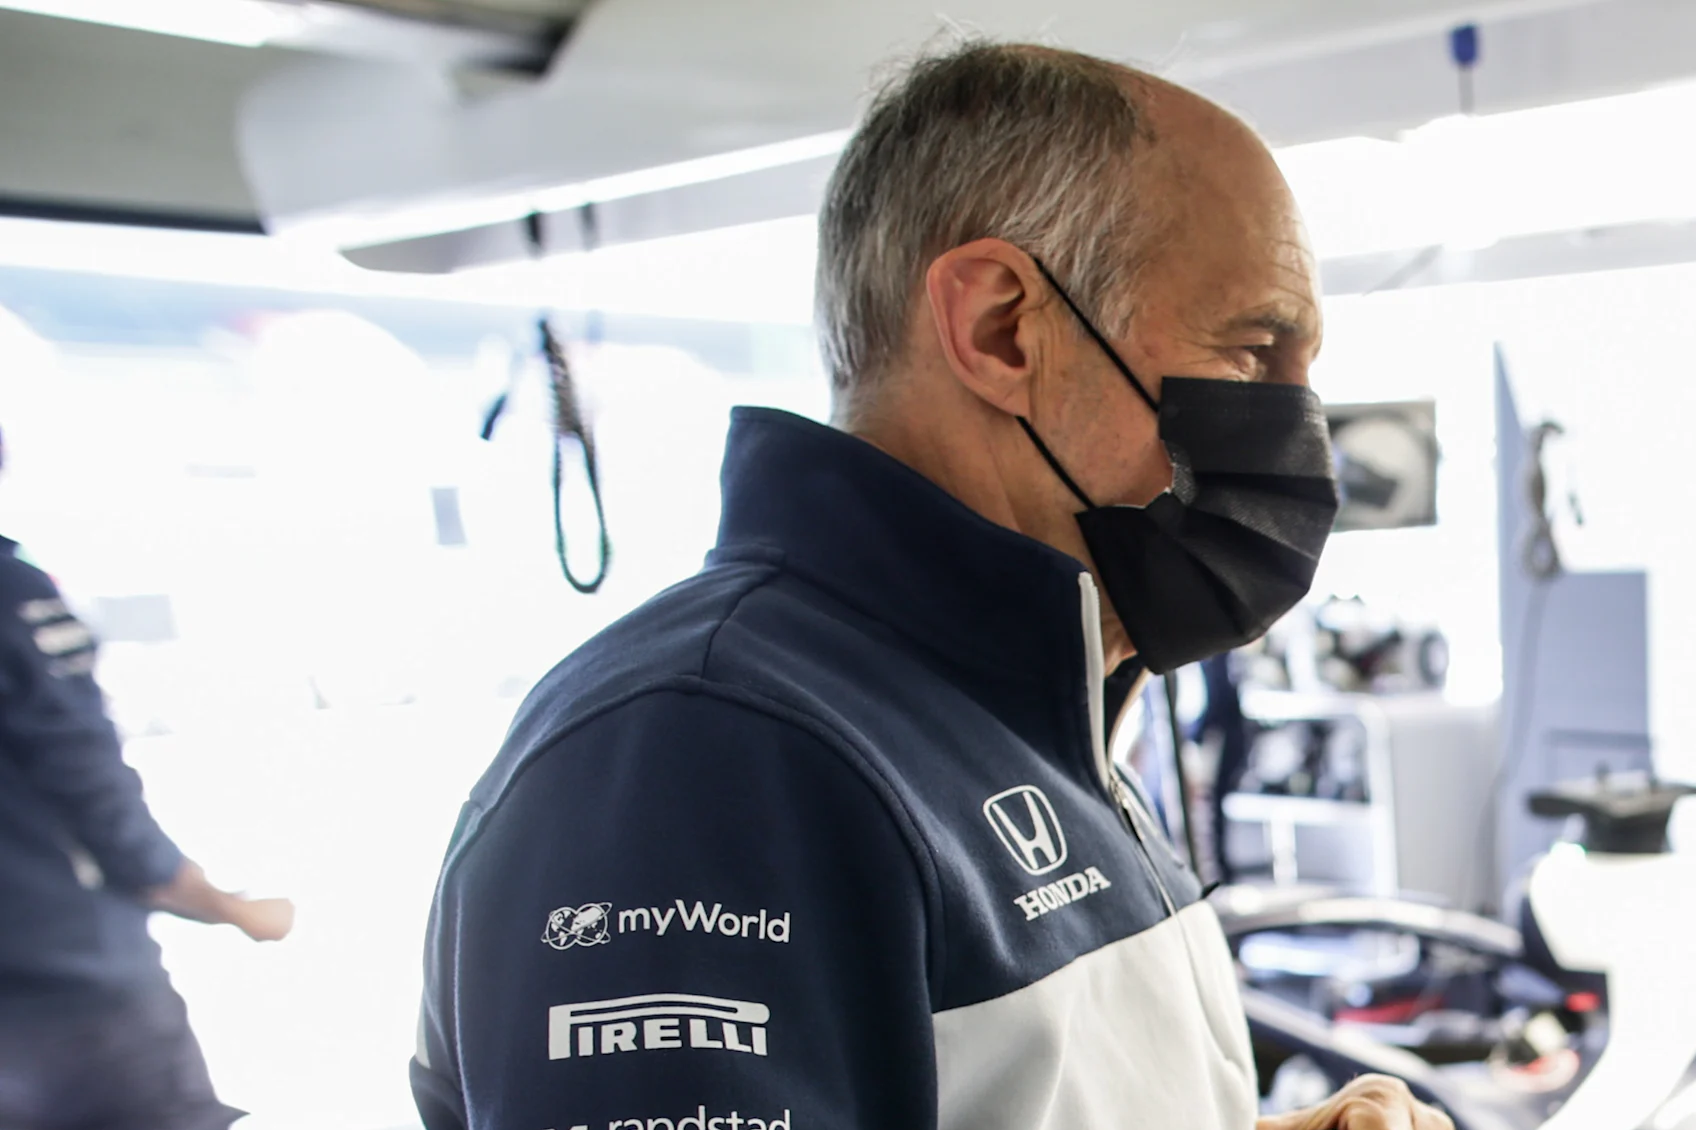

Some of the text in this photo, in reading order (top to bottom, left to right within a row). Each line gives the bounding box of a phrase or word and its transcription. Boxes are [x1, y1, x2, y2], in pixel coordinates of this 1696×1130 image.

[618, 899, 791, 943] myWorld
[1013, 866, 1111, 921] HONDA
[548, 993, 770, 1061] PIRELLI
